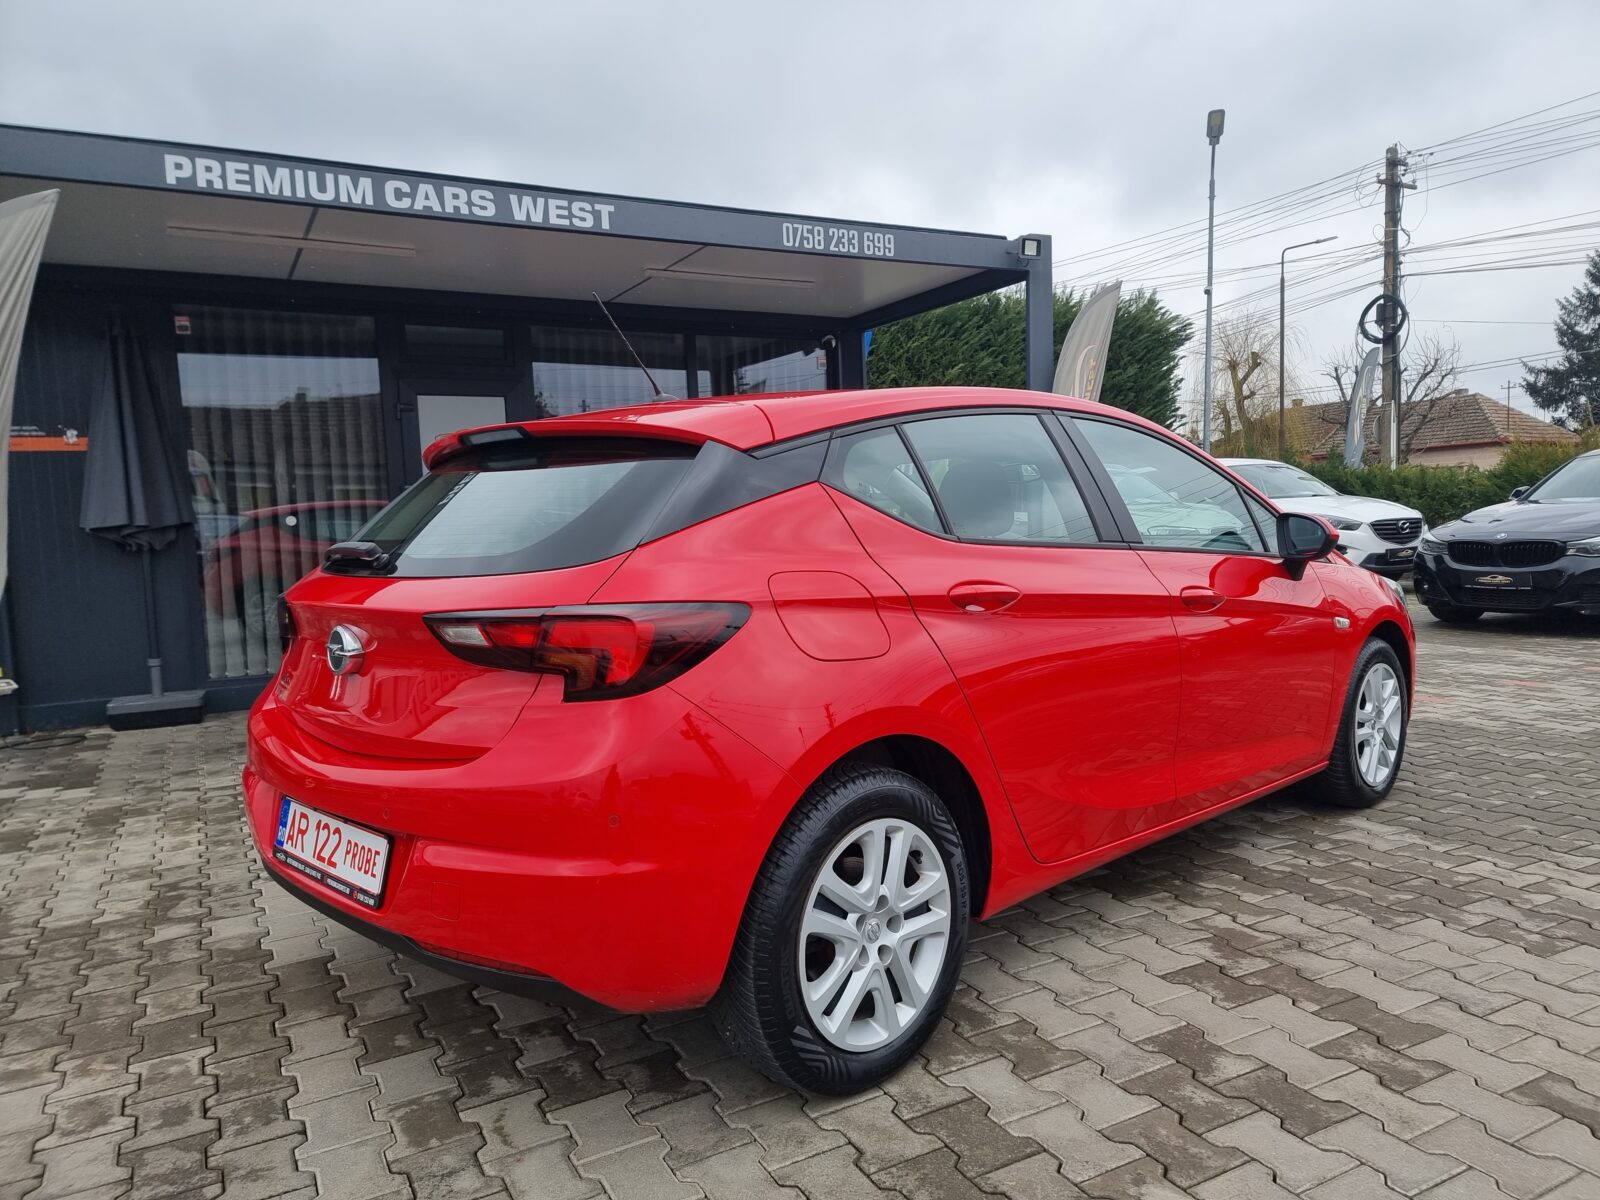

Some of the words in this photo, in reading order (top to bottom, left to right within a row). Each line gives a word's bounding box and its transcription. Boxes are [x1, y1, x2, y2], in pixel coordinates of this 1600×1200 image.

[163, 153, 374, 205] PREMIUM
[384, 180, 496, 217] CARS
[509, 194, 615, 230] WEST
[782, 222, 824, 250] 0758
[829, 227, 859, 253] 233
[863, 231, 895, 257] 699
[286, 808, 310, 853] AR
[312, 819, 342, 869] 122
[343, 839, 381, 879] PROBE
